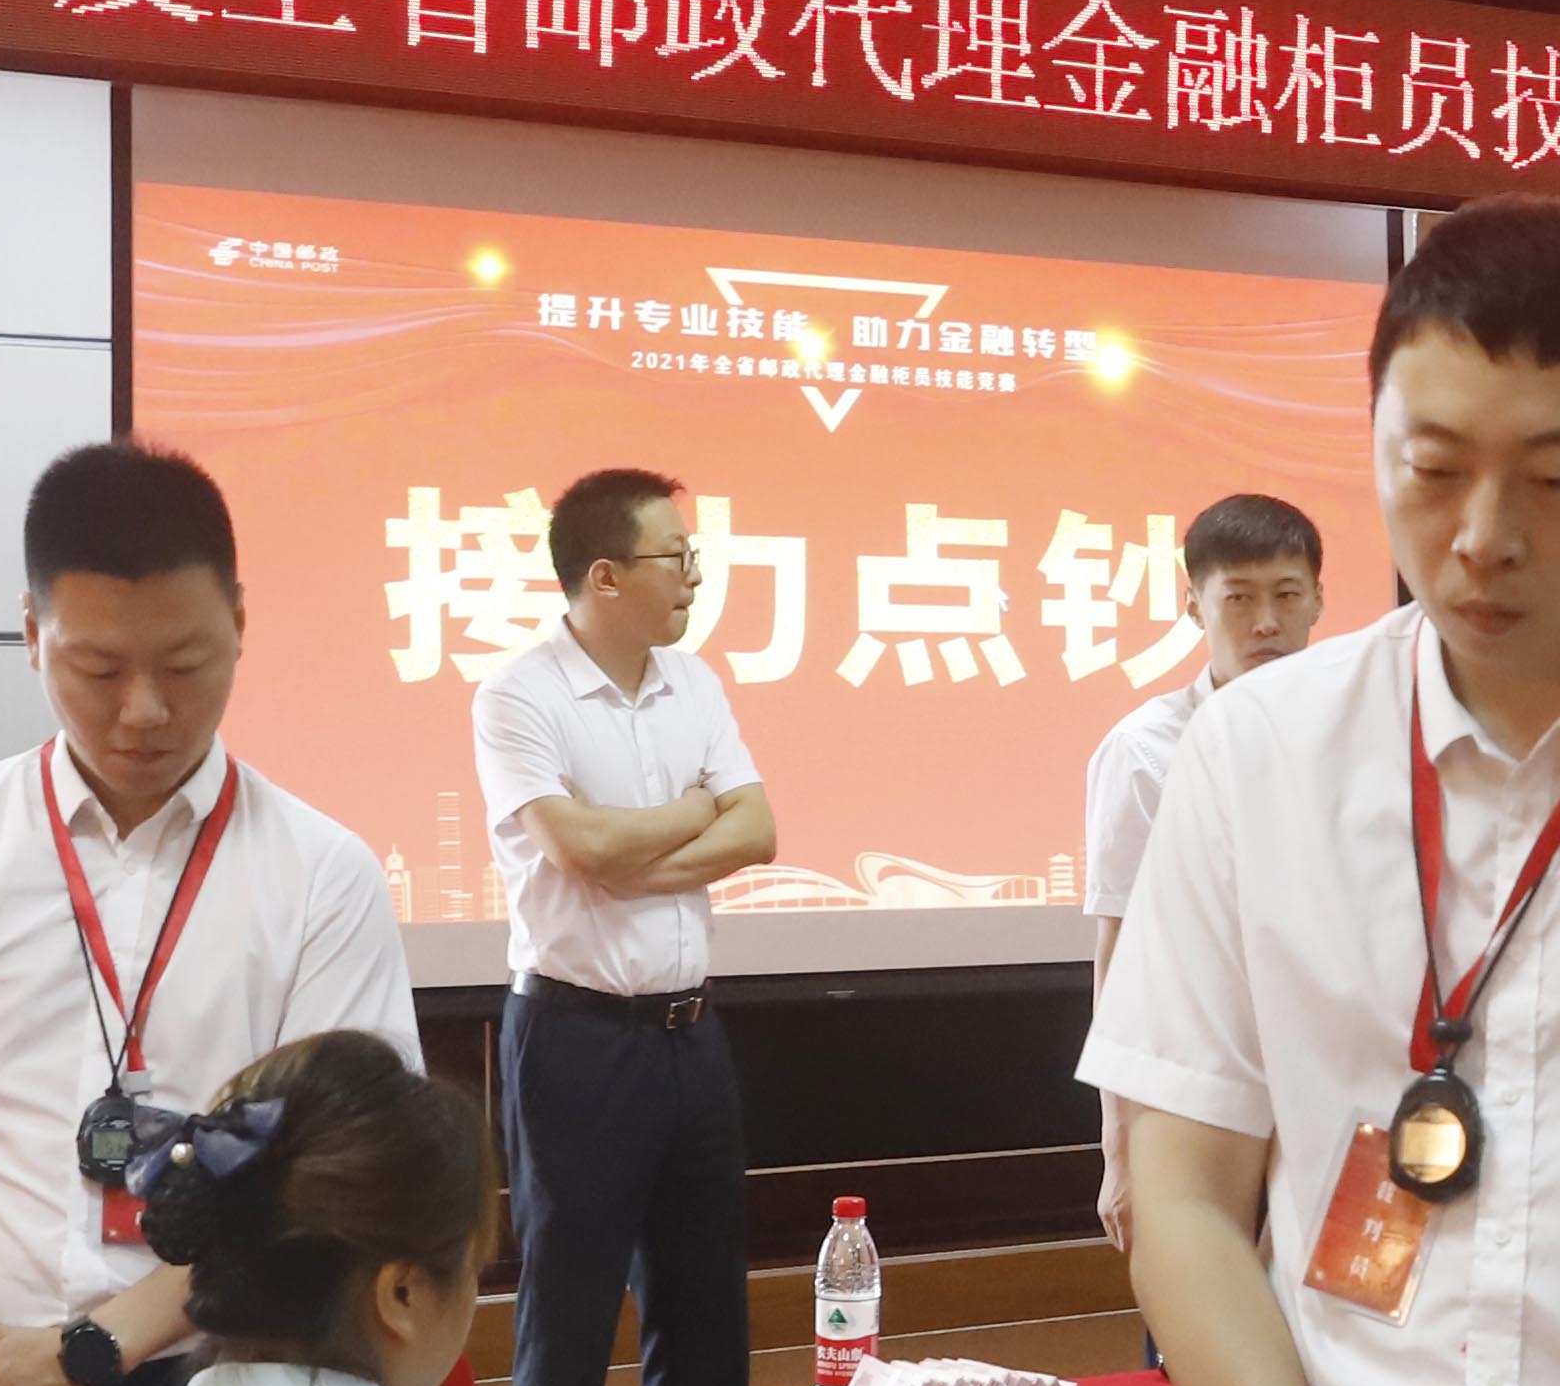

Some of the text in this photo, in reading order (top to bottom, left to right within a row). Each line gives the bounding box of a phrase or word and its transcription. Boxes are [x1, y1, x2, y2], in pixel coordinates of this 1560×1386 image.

[248, 241, 340, 261] 中国邮政
[249, 257, 339, 272] CHINA POST
[538, 293, 1099, 361] 提升专业技能 助力金融转型
[631, 351, 1017, 392] 2021年全省邮政代理金融柜员技能竞赛
